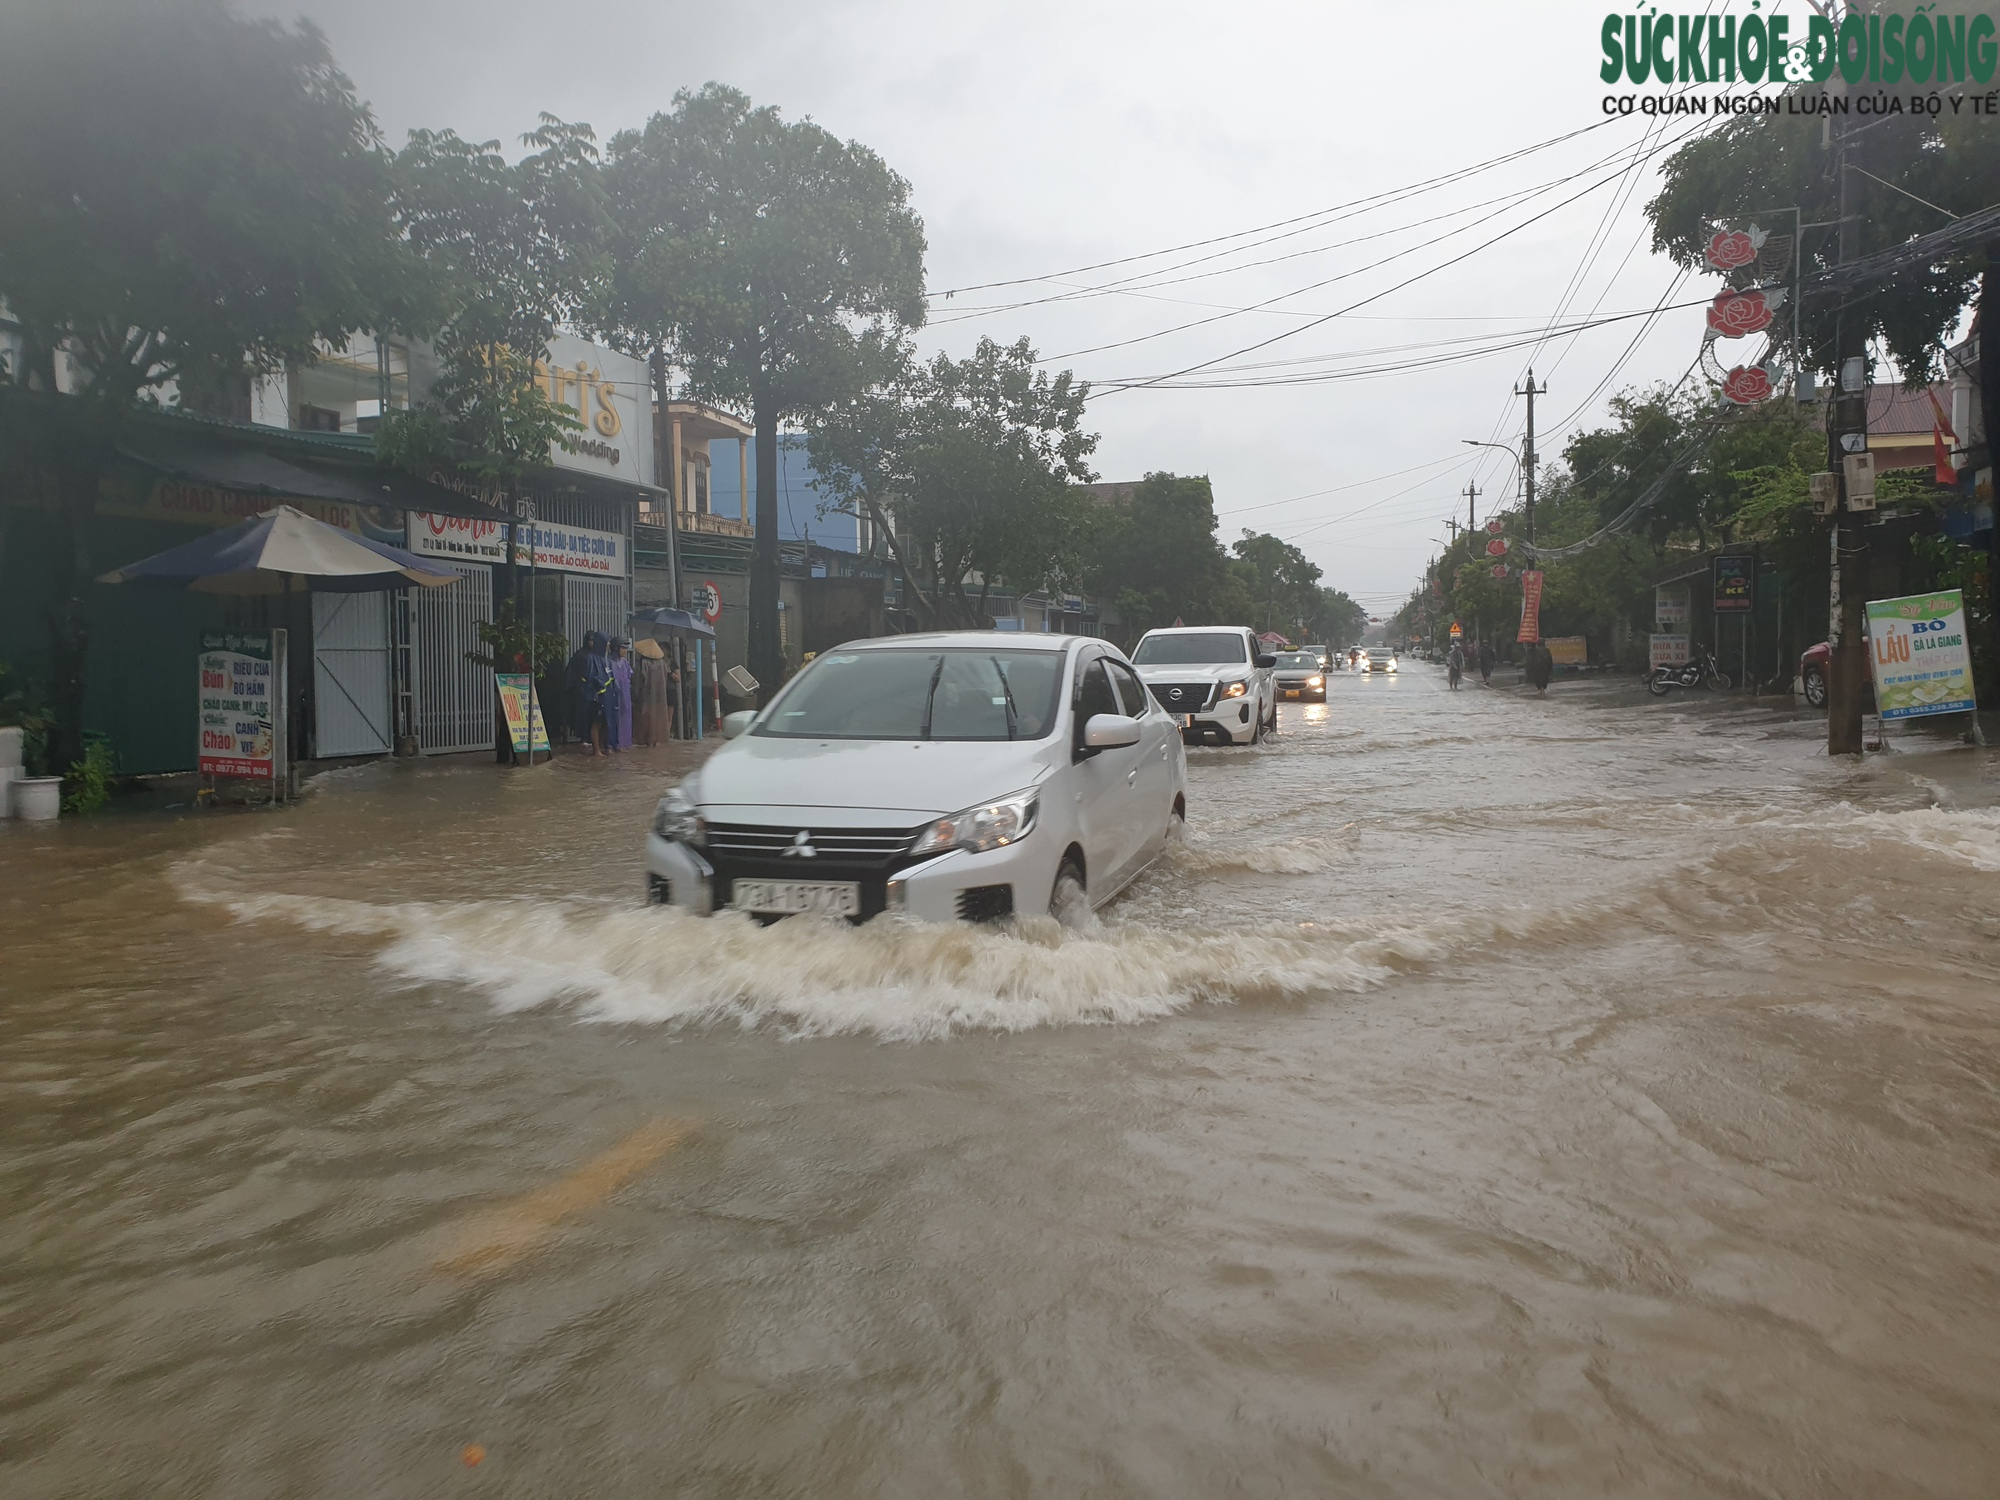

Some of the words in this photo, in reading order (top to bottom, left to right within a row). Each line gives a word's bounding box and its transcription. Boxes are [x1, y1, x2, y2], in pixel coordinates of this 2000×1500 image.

[566, 433, 620, 465] Wedding
[1911, 617, 1946, 634] BÒ
[1675, 642, 1687, 650] XE
[1876, 624, 1910, 665] LẨU
[1914, 637, 1926, 651] GÀ
[1938, 634, 1962, 648] GIANG
[202, 669, 224, 689] Bún
[203, 730, 231, 750] Cháo
